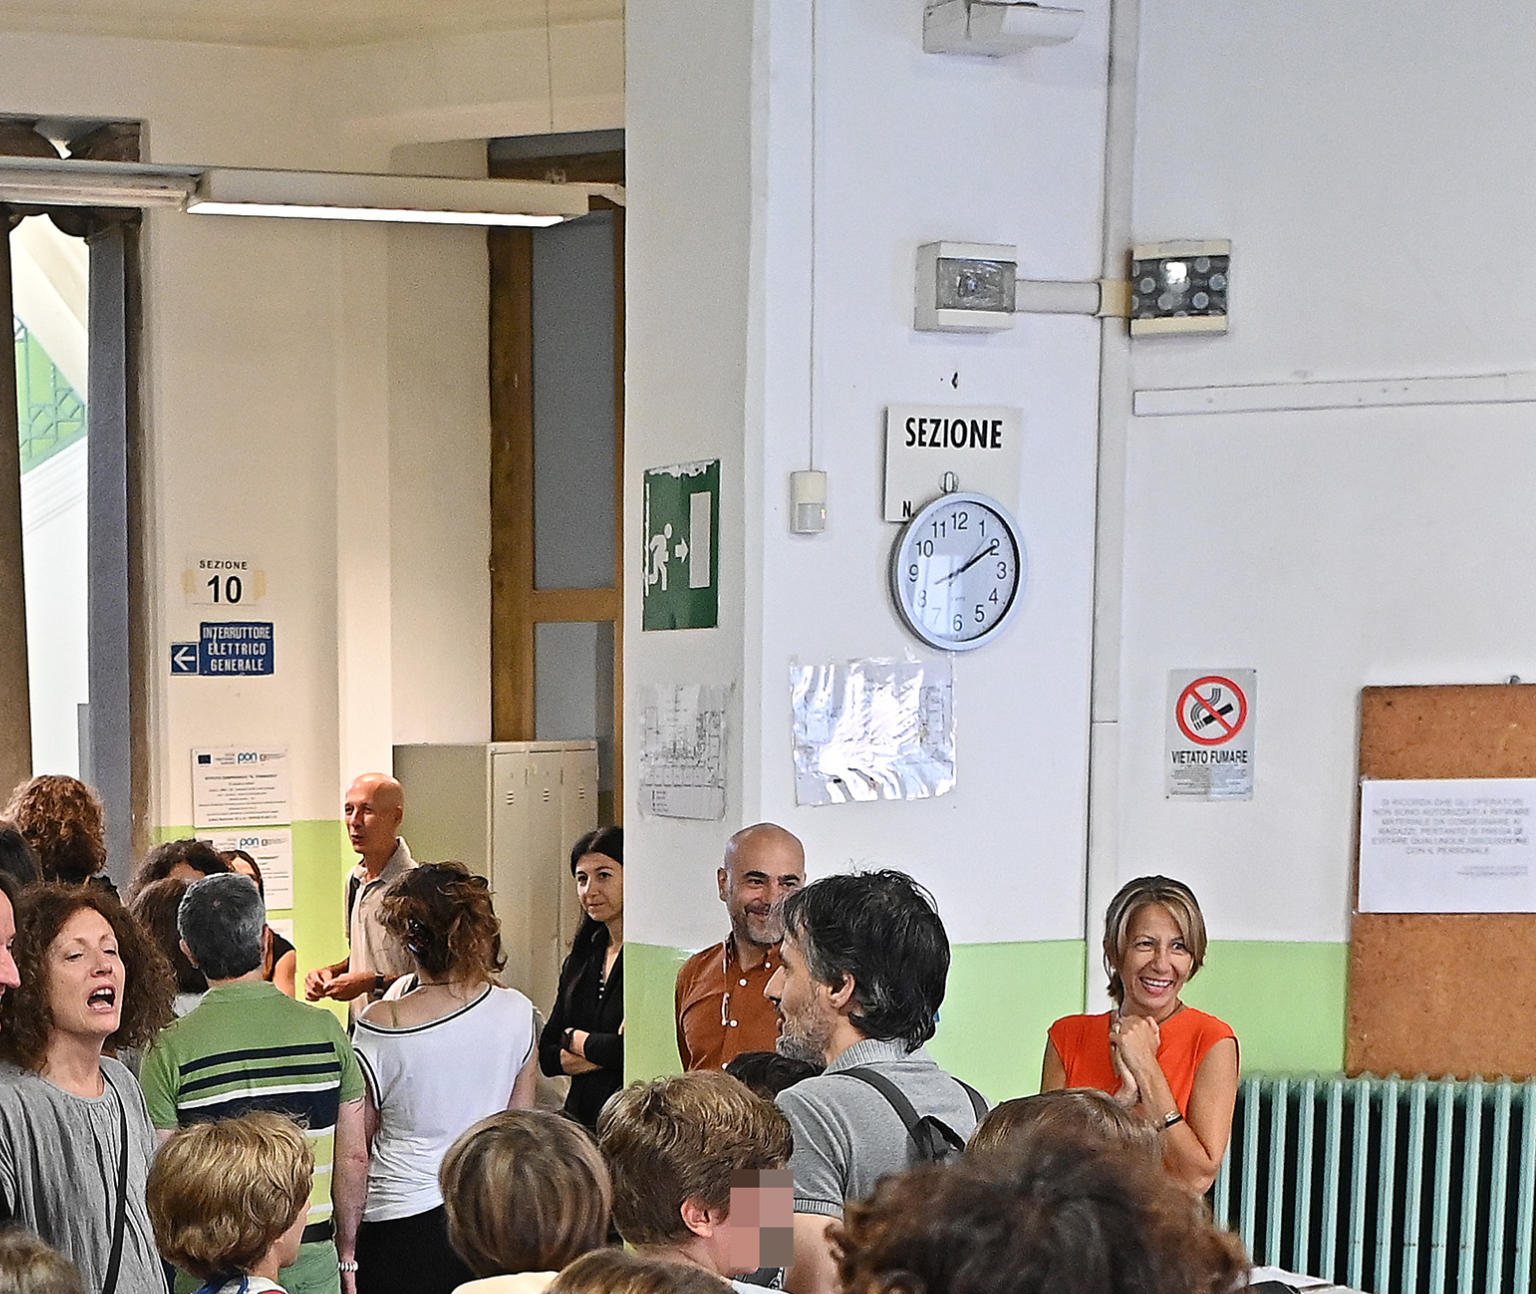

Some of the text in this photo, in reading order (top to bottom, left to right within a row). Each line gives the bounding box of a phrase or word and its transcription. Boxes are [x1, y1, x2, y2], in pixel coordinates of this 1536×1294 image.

[905, 417, 1003, 449] SEZIONE
[931, 521, 946, 538] 11
[951, 512, 969, 530] 12
[979, 520, 985, 536] 1
[916, 540, 934, 557] 10
[989, 538, 1000, 556] 2
[199, 560, 248, 570] SEZIONE
[909, 564, 919, 582] 9
[996, 562, 1007, 579] 3
[207, 574, 242, 604] 10
[988, 588, 998, 604] 4
[975, 605, 985, 622] 5
[953, 614, 963, 631] 6
[203, 627, 271, 639] INTERRUTTORE
[208, 643, 266, 656] ELETTRICO
[210, 659, 264, 672] GENERALE
[1171, 750, 1248, 764] VIETATO FUMARE
